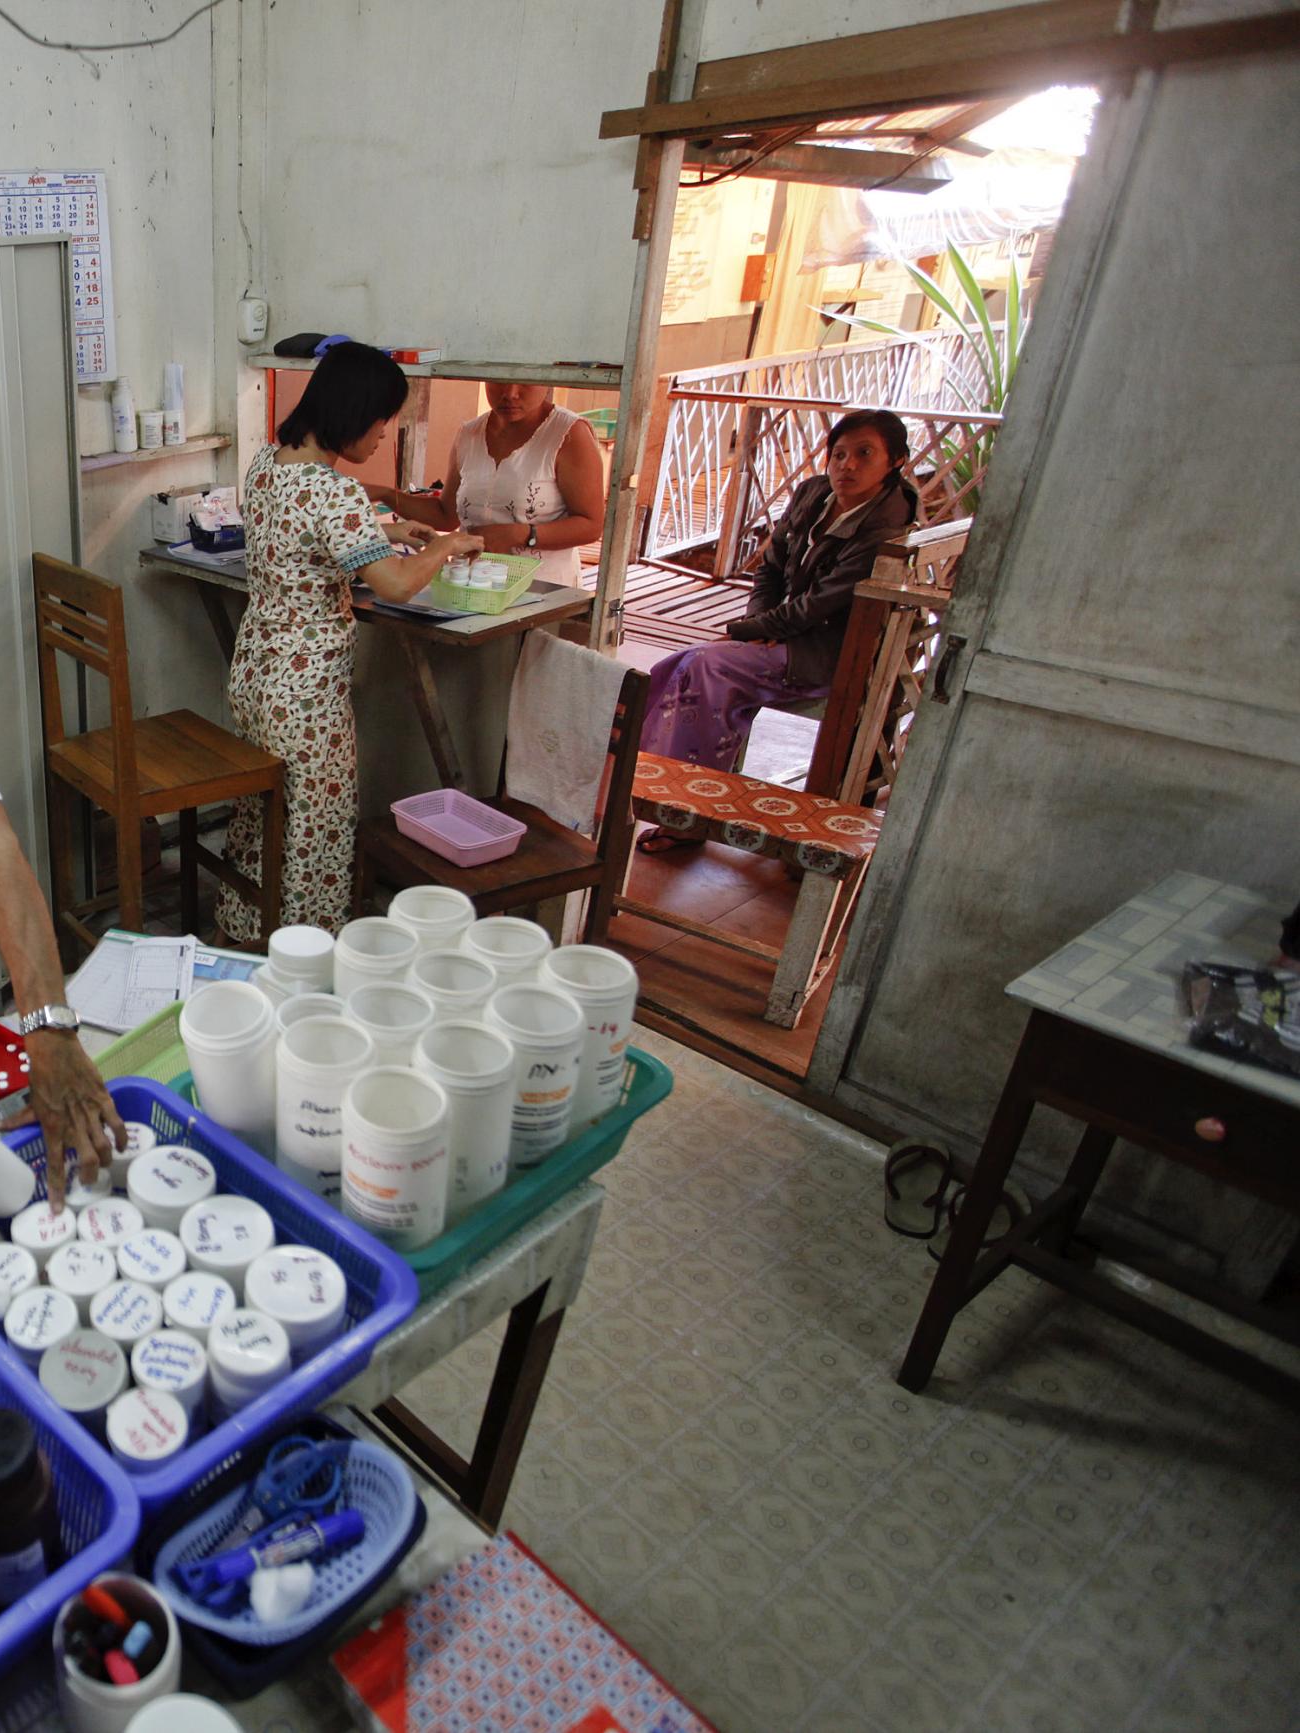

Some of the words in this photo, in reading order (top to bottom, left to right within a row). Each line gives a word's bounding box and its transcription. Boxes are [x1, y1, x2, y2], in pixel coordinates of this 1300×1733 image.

[73, 258, 80, 268] 3
[90, 257, 97, 267] 4
[85, 271, 97, 281] 11
[85, 283, 98, 293] 18
[86, 297, 99, 306] 25
